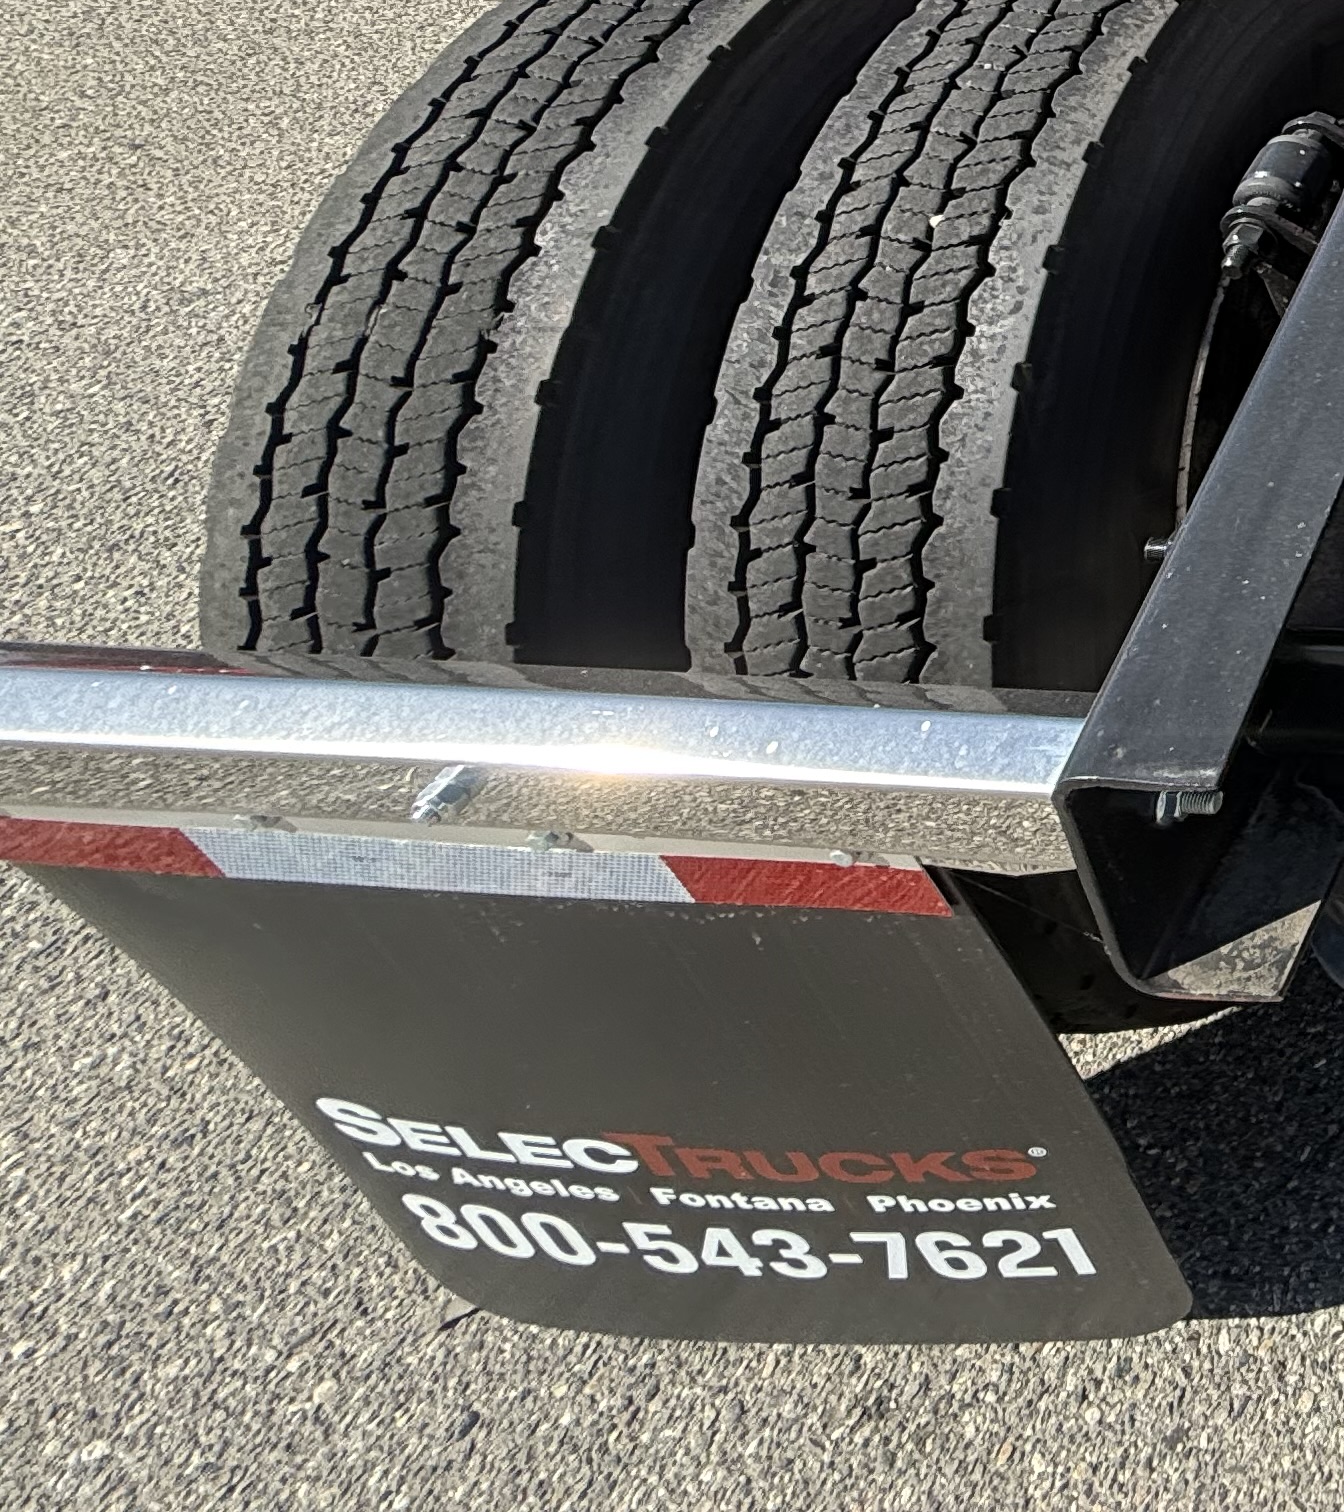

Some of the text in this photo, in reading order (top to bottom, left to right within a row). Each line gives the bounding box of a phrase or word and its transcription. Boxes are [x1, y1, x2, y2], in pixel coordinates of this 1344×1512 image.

[362, 1152, 1057, 1213] Los Angeles Fontana Phoenix
[402, 1193, 1098, 1280] 800-543-7621
